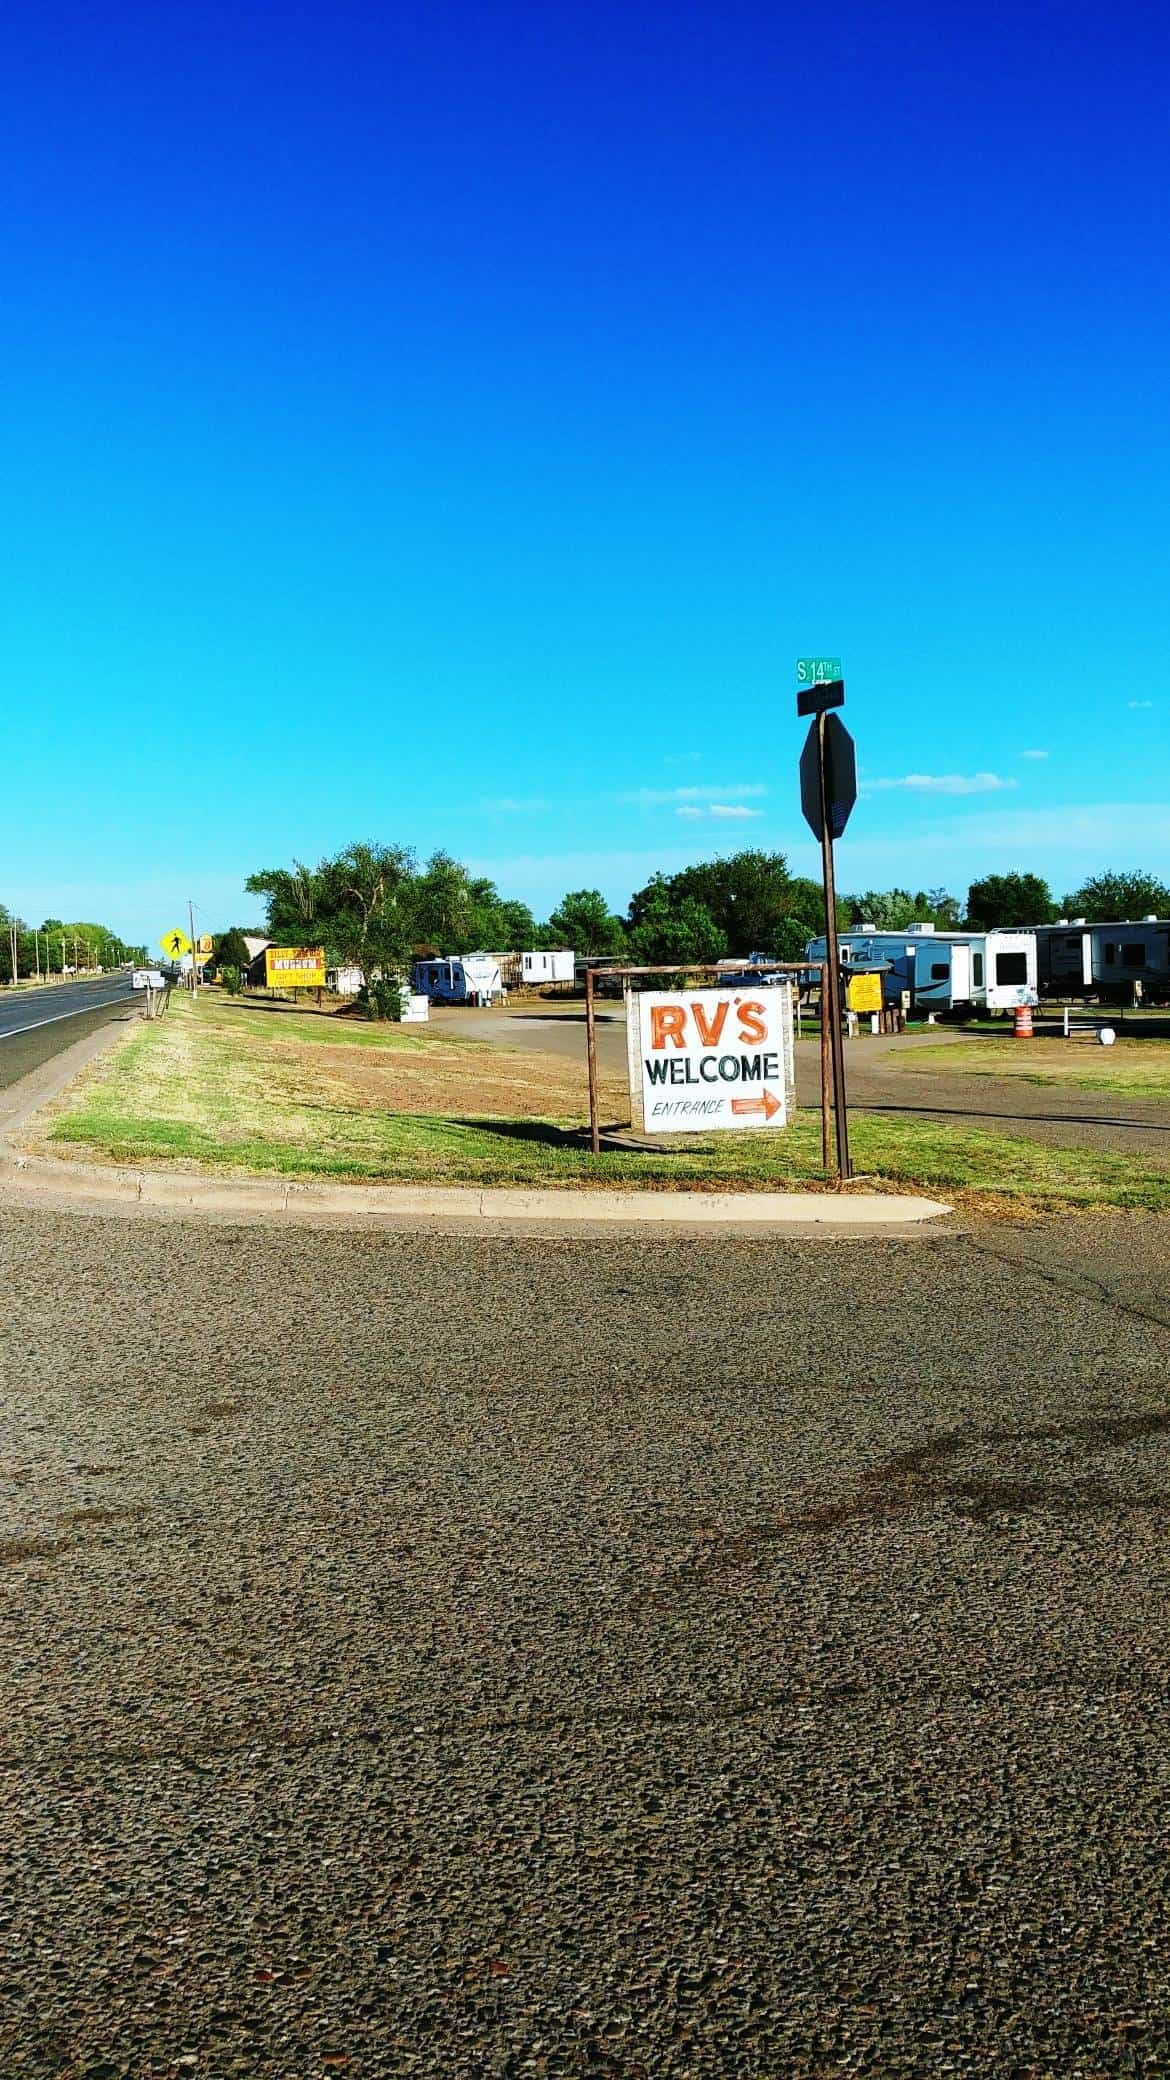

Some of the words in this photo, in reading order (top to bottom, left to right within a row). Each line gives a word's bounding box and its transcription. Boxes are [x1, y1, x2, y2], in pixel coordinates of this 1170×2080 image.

[650, 997, 768, 1050] RV'S
[645, 1053, 779, 1086] WELCOME
[651, 1099, 727, 1117] ENTRANCE
